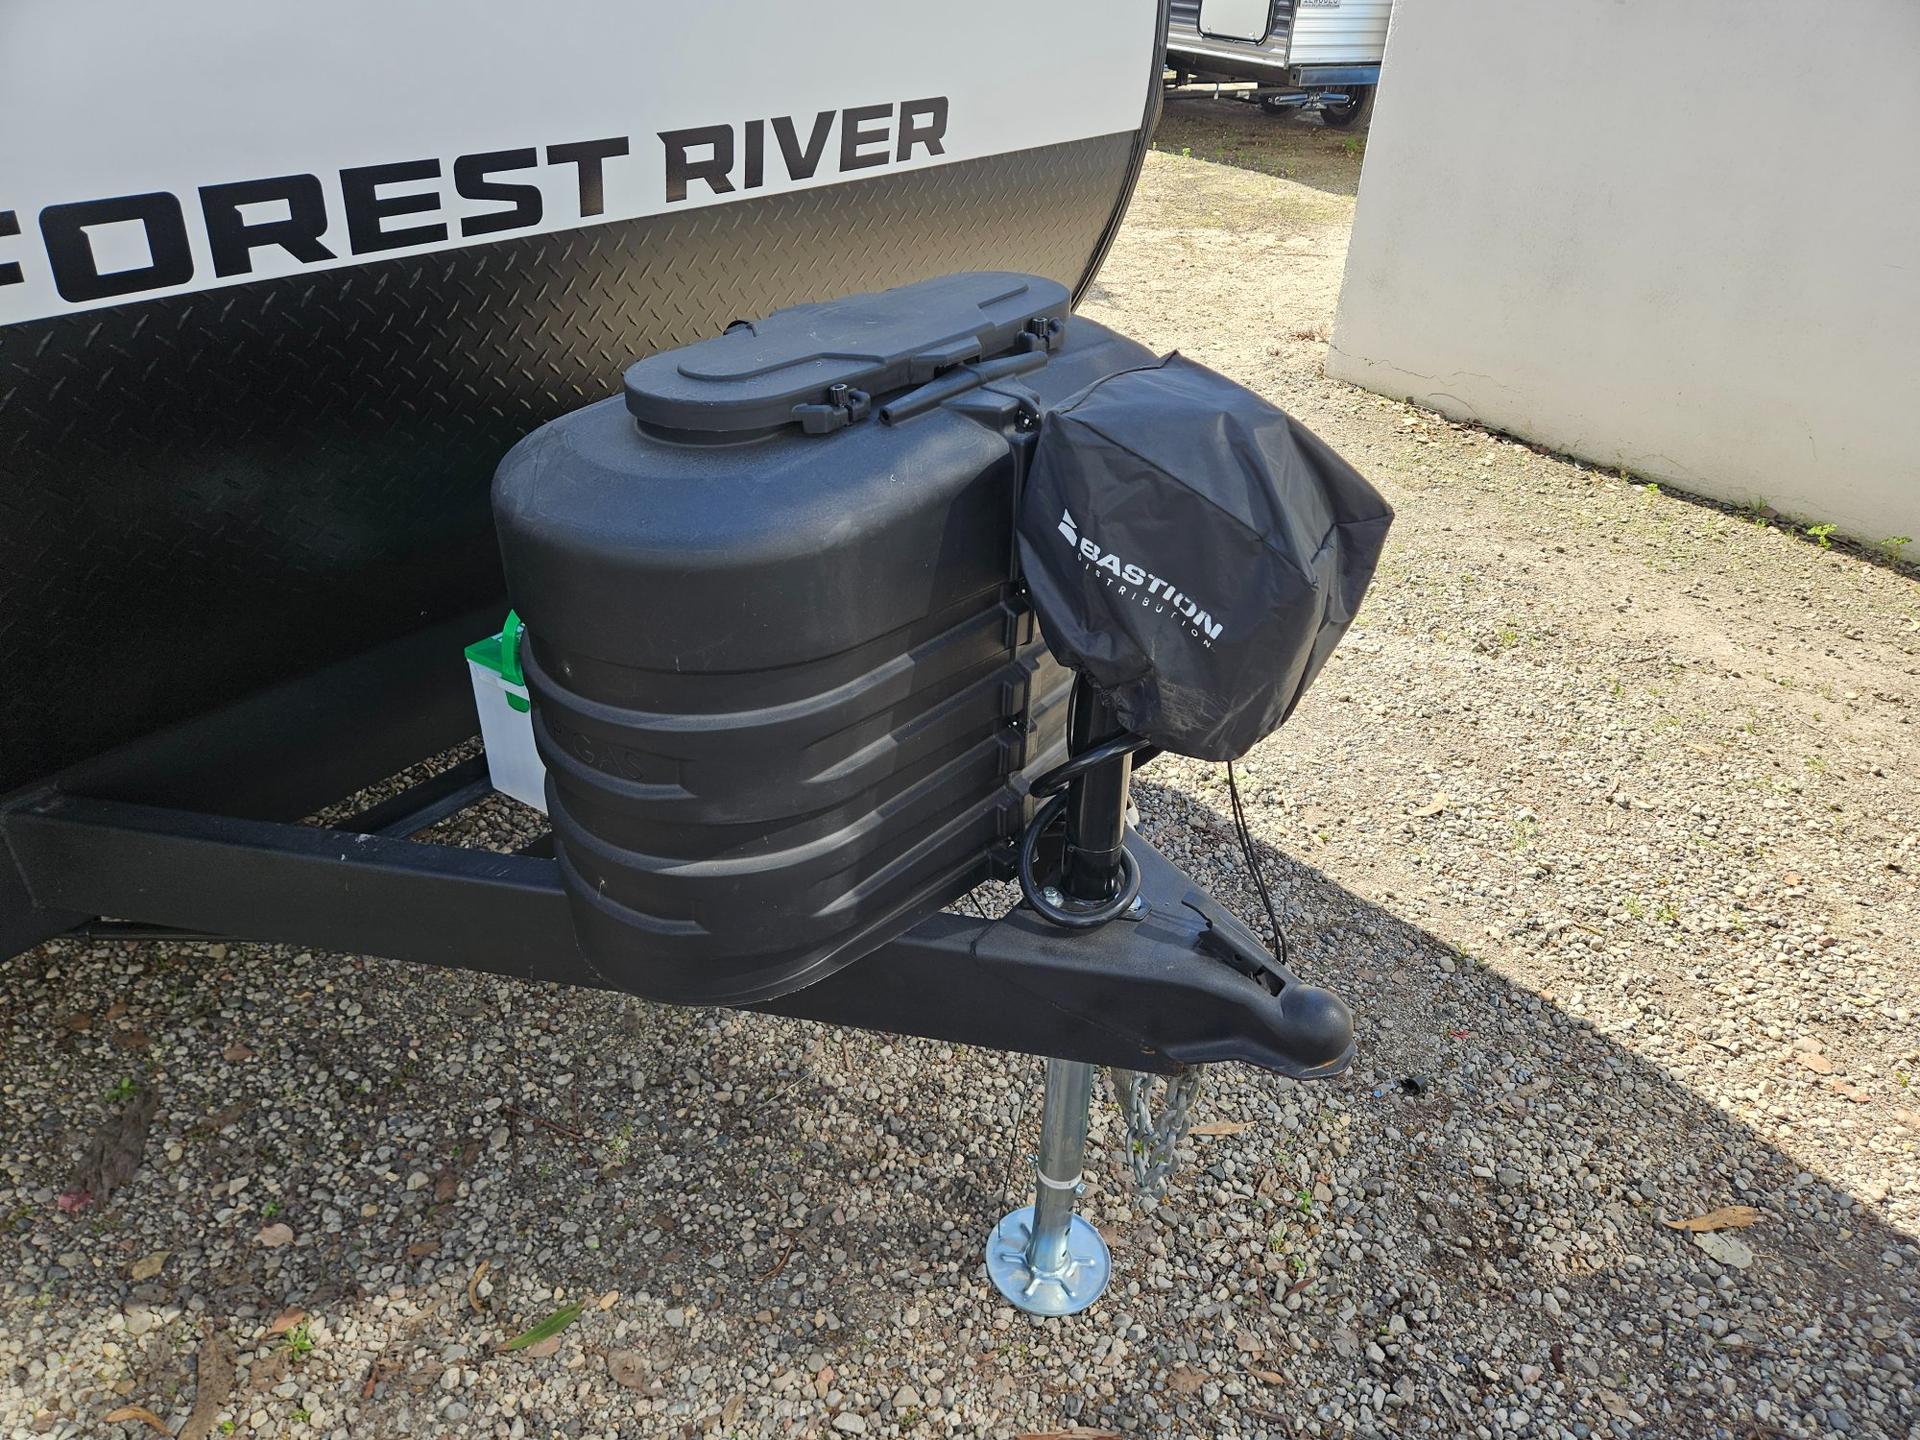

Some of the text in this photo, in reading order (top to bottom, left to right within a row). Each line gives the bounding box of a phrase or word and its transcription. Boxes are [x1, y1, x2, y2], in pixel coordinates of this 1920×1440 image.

[0, 96, 949, 302] OREST RIVER
[1077, 553, 1212, 648] DISTRIBUTION
[1080, 537, 1223, 639] BASTION
